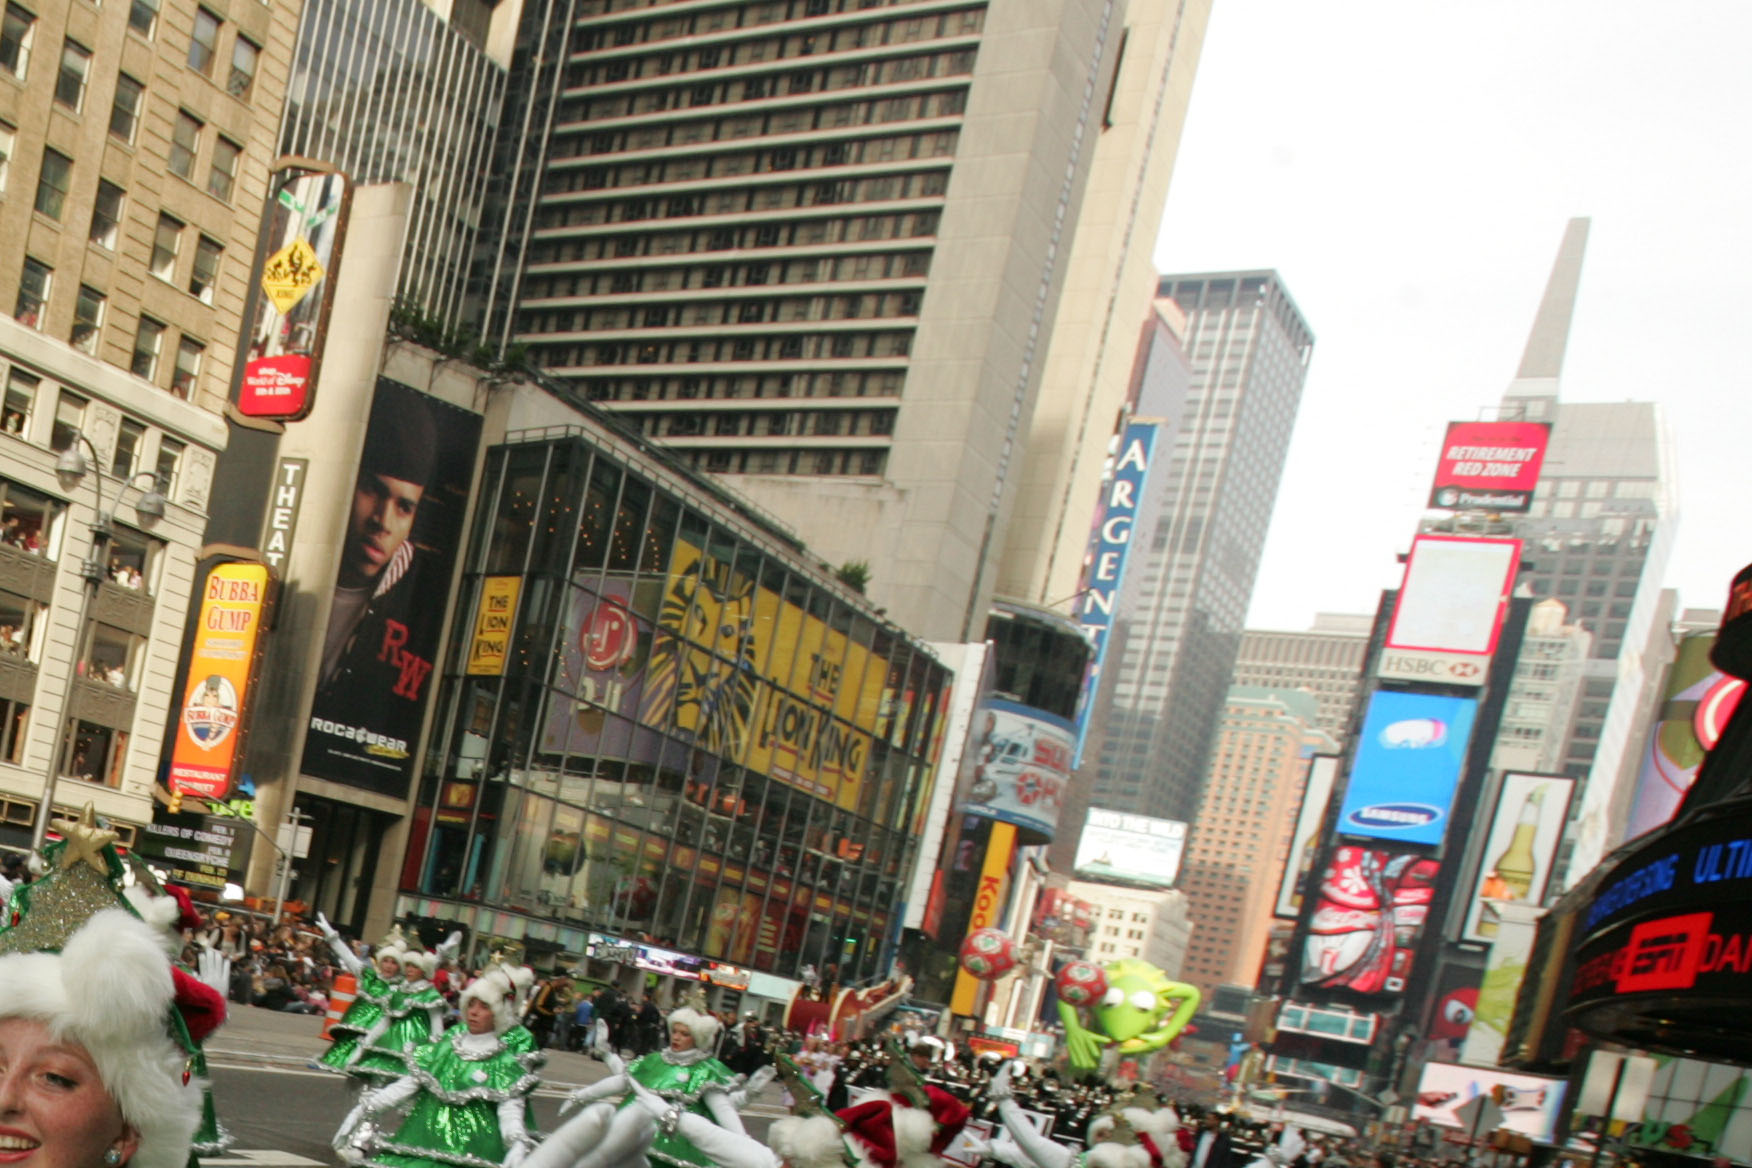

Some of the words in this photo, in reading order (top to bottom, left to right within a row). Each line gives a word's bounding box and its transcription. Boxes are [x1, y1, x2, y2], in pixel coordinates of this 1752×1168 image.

[1446, 446, 1538, 462] RETIREMENT
[1452, 461, 1483, 476] RED
[1480, 463, 1523, 477] ZONE
[1459, 492, 1525, 506] Prudential
[208, 575, 260, 602] BUBBA
[489, 595, 509, 609] THE
[207, 606, 252, 631] GUMP
[479, 614, 509, 636] LION
[473, 639, 505, 661] KING
[1384, 654, 1447, 676] HSBC
[1360, 807, 1430, 825] SAMSUNG
[180, 828, 193, 840] OF
[193, 830, 234, 847] COMEDY
